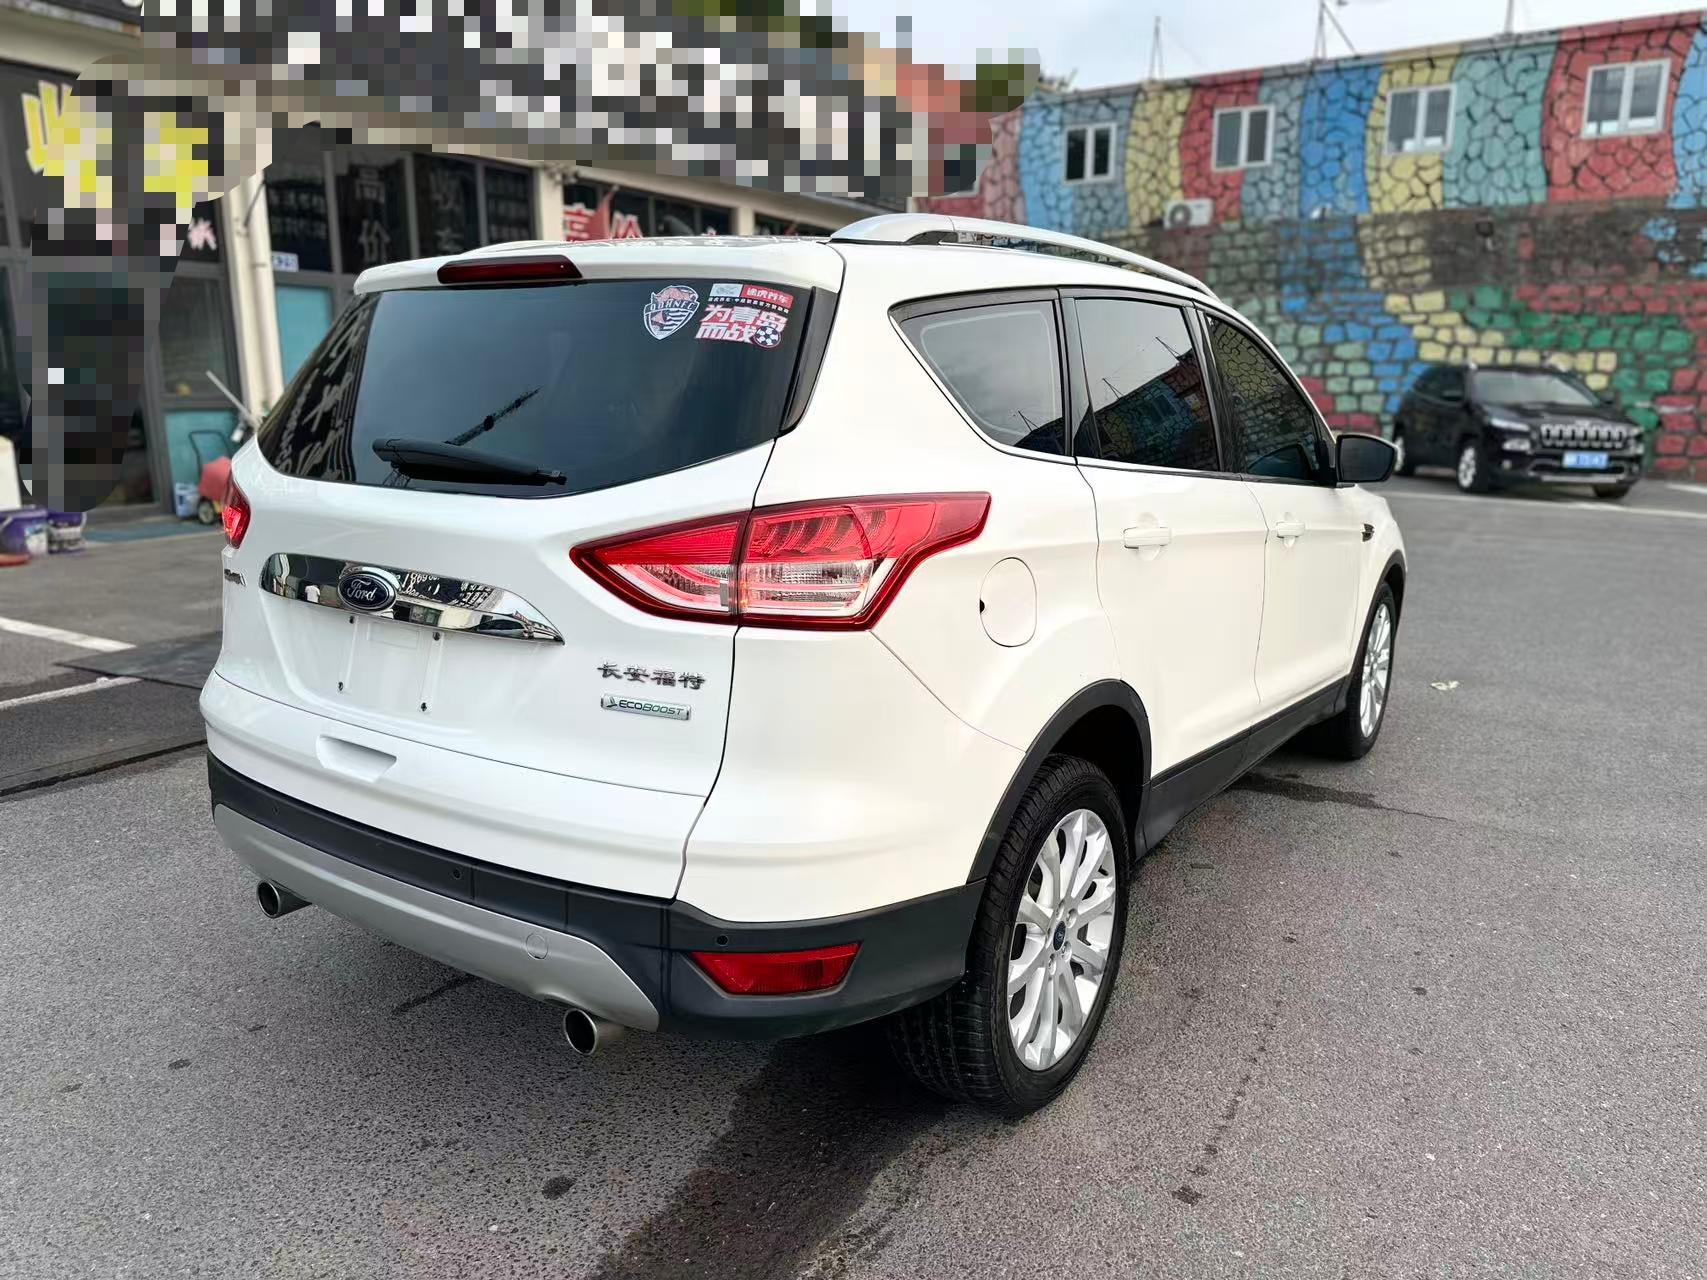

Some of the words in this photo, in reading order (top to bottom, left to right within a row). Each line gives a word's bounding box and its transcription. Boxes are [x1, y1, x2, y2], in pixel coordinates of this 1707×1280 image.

[700, 304, 788, 332] 为青岛
[695, 321, 757, 344] 而战
[347, 579, 378, 602] Ford
[597, 661, 706, 690] 长安福特
[619, 699, 685, 716] ECOBOOST
